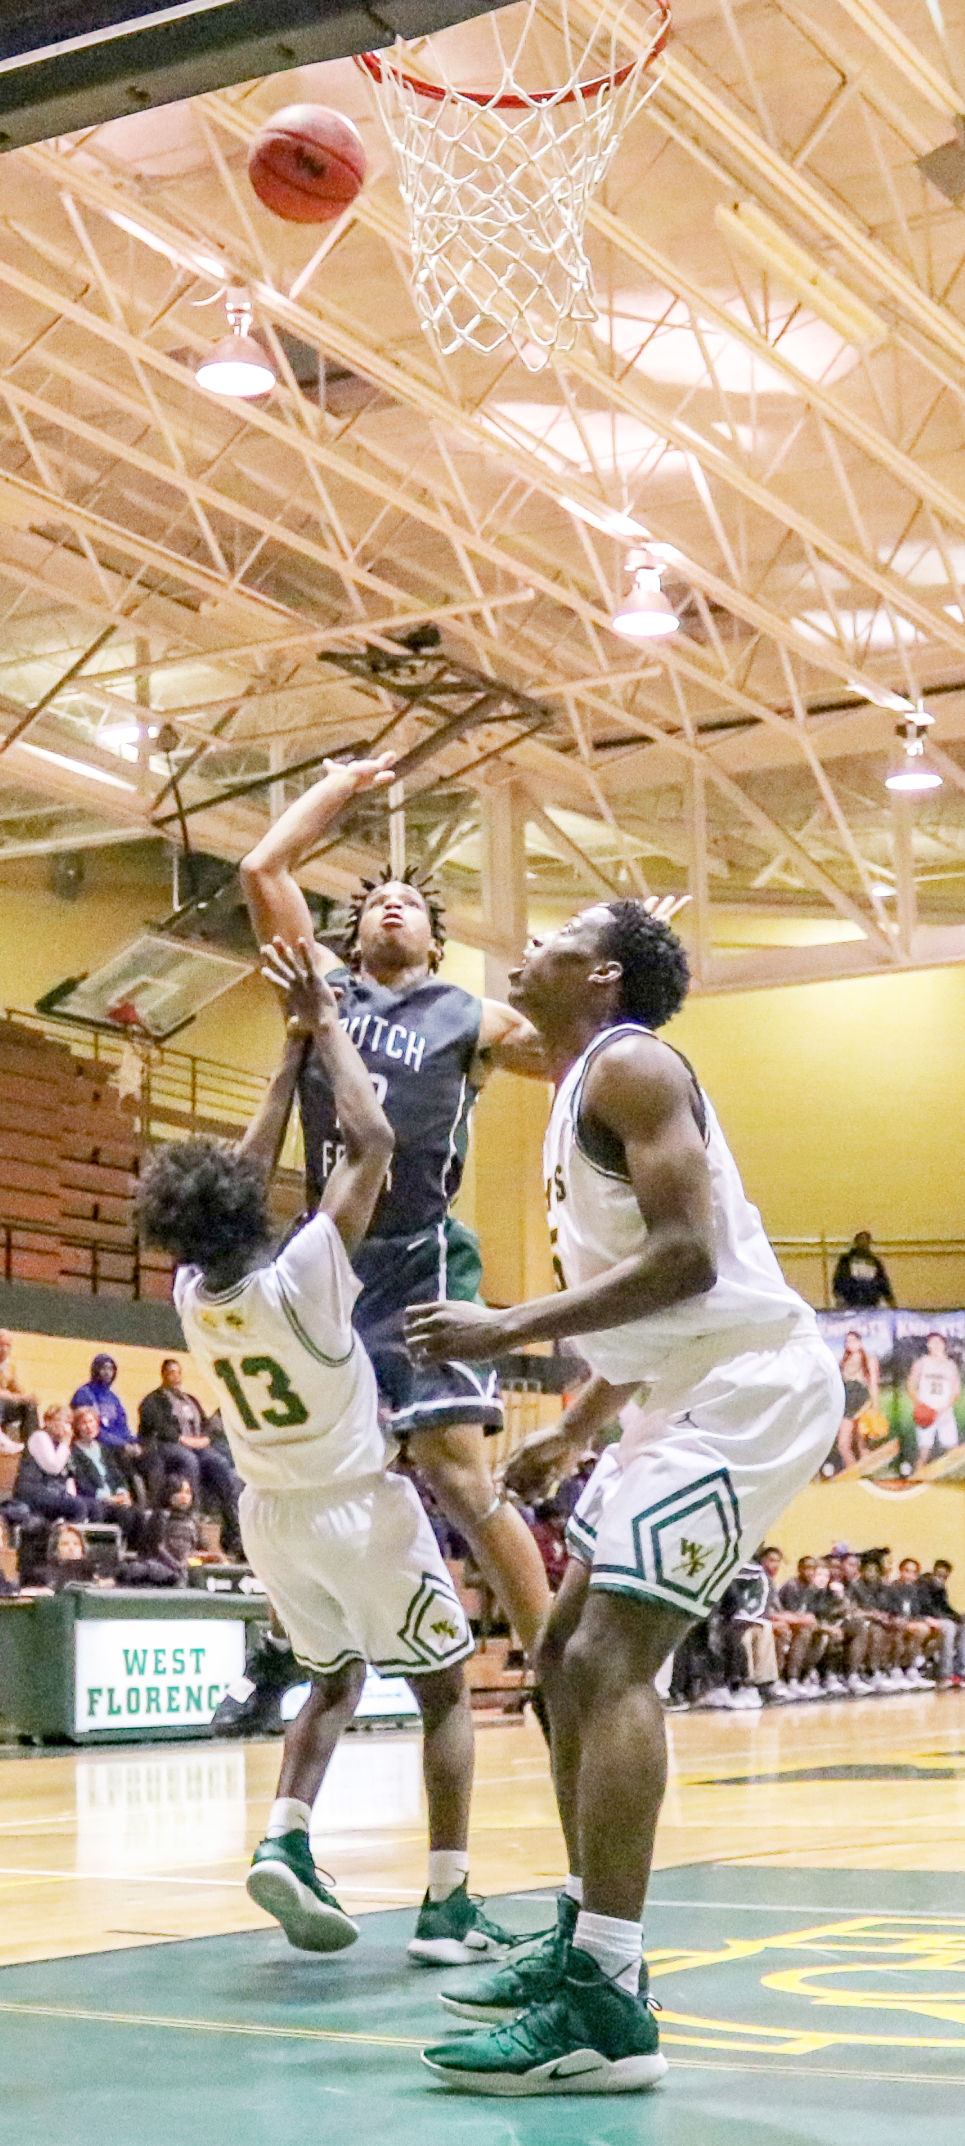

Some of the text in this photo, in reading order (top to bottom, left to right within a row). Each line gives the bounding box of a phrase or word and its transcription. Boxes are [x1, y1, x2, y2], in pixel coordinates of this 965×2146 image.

[213, 1355, 310, 1430] 13
[122, 1647, 206, 1676] WEST
[87, 1684, 230, 1716] FLORENC
